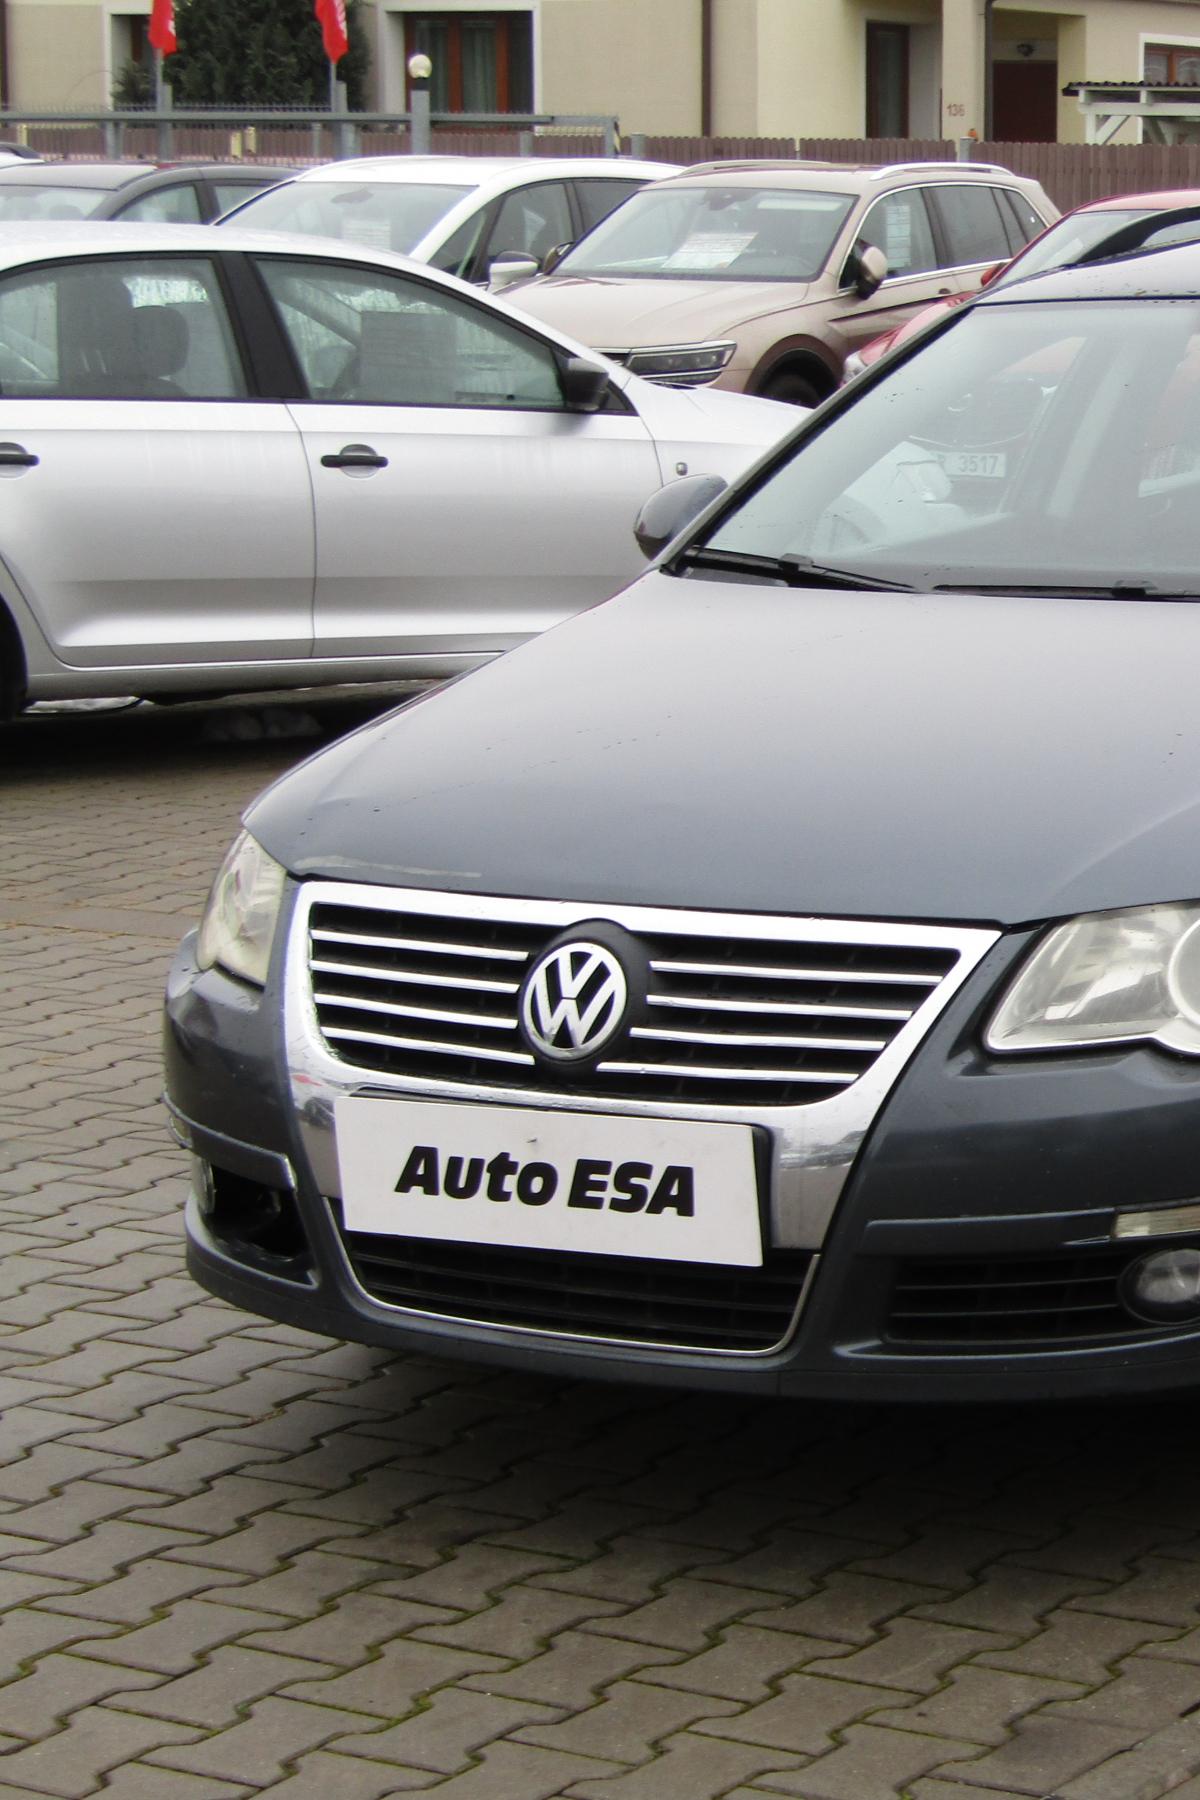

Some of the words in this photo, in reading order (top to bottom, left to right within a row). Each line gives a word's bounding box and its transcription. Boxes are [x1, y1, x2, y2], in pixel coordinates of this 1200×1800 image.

[958, 455, 998, 474] 3517
[523, 942, 627, 1059] VW
[394, 1145, 560, 1207] Auto
[567, 1159, 696, 1218] ESA
